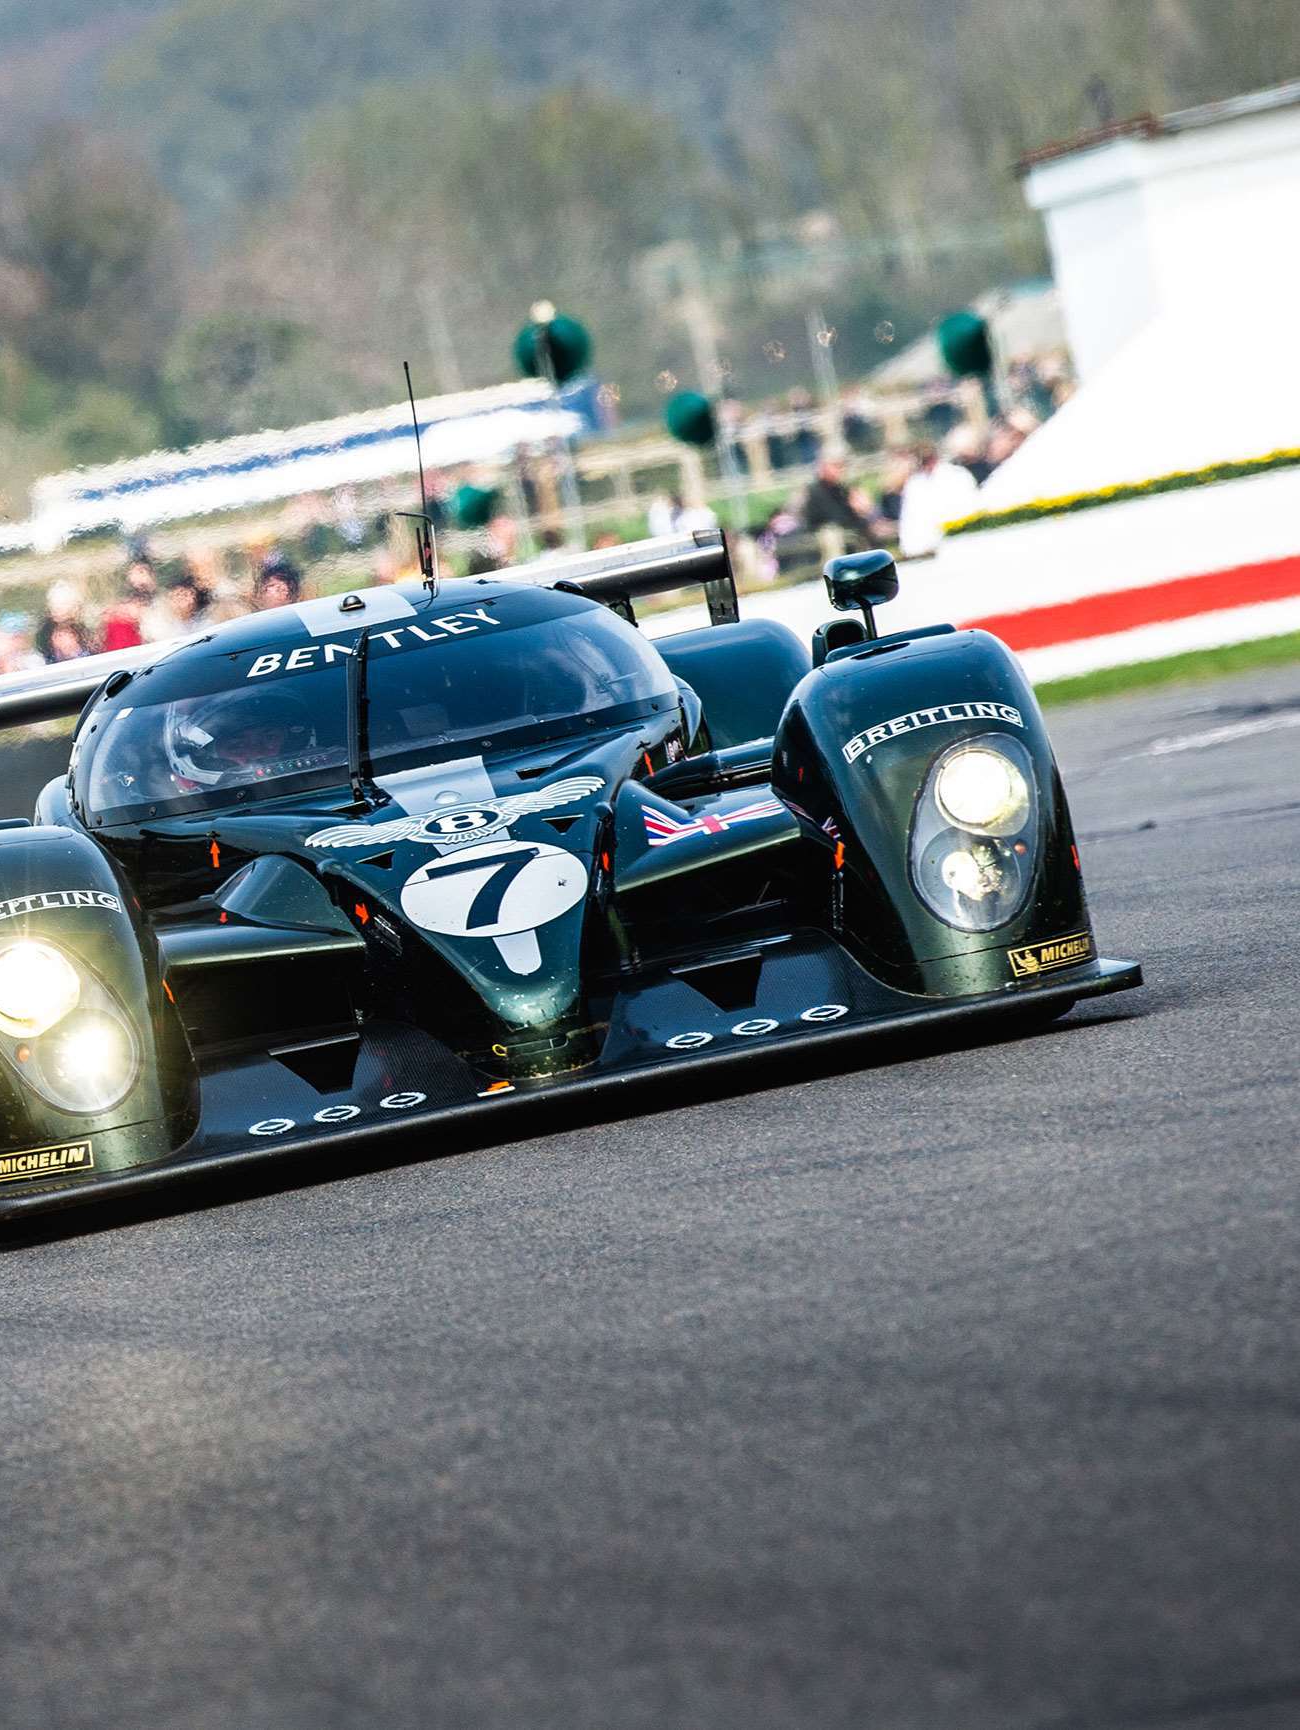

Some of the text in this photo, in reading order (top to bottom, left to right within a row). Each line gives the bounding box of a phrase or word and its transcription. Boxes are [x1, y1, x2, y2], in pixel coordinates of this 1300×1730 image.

[247, 608, 501, 678] BENTLEY
[847, 703, 1022, 759] BREITLING
[425, 847, 540, 931] 7
